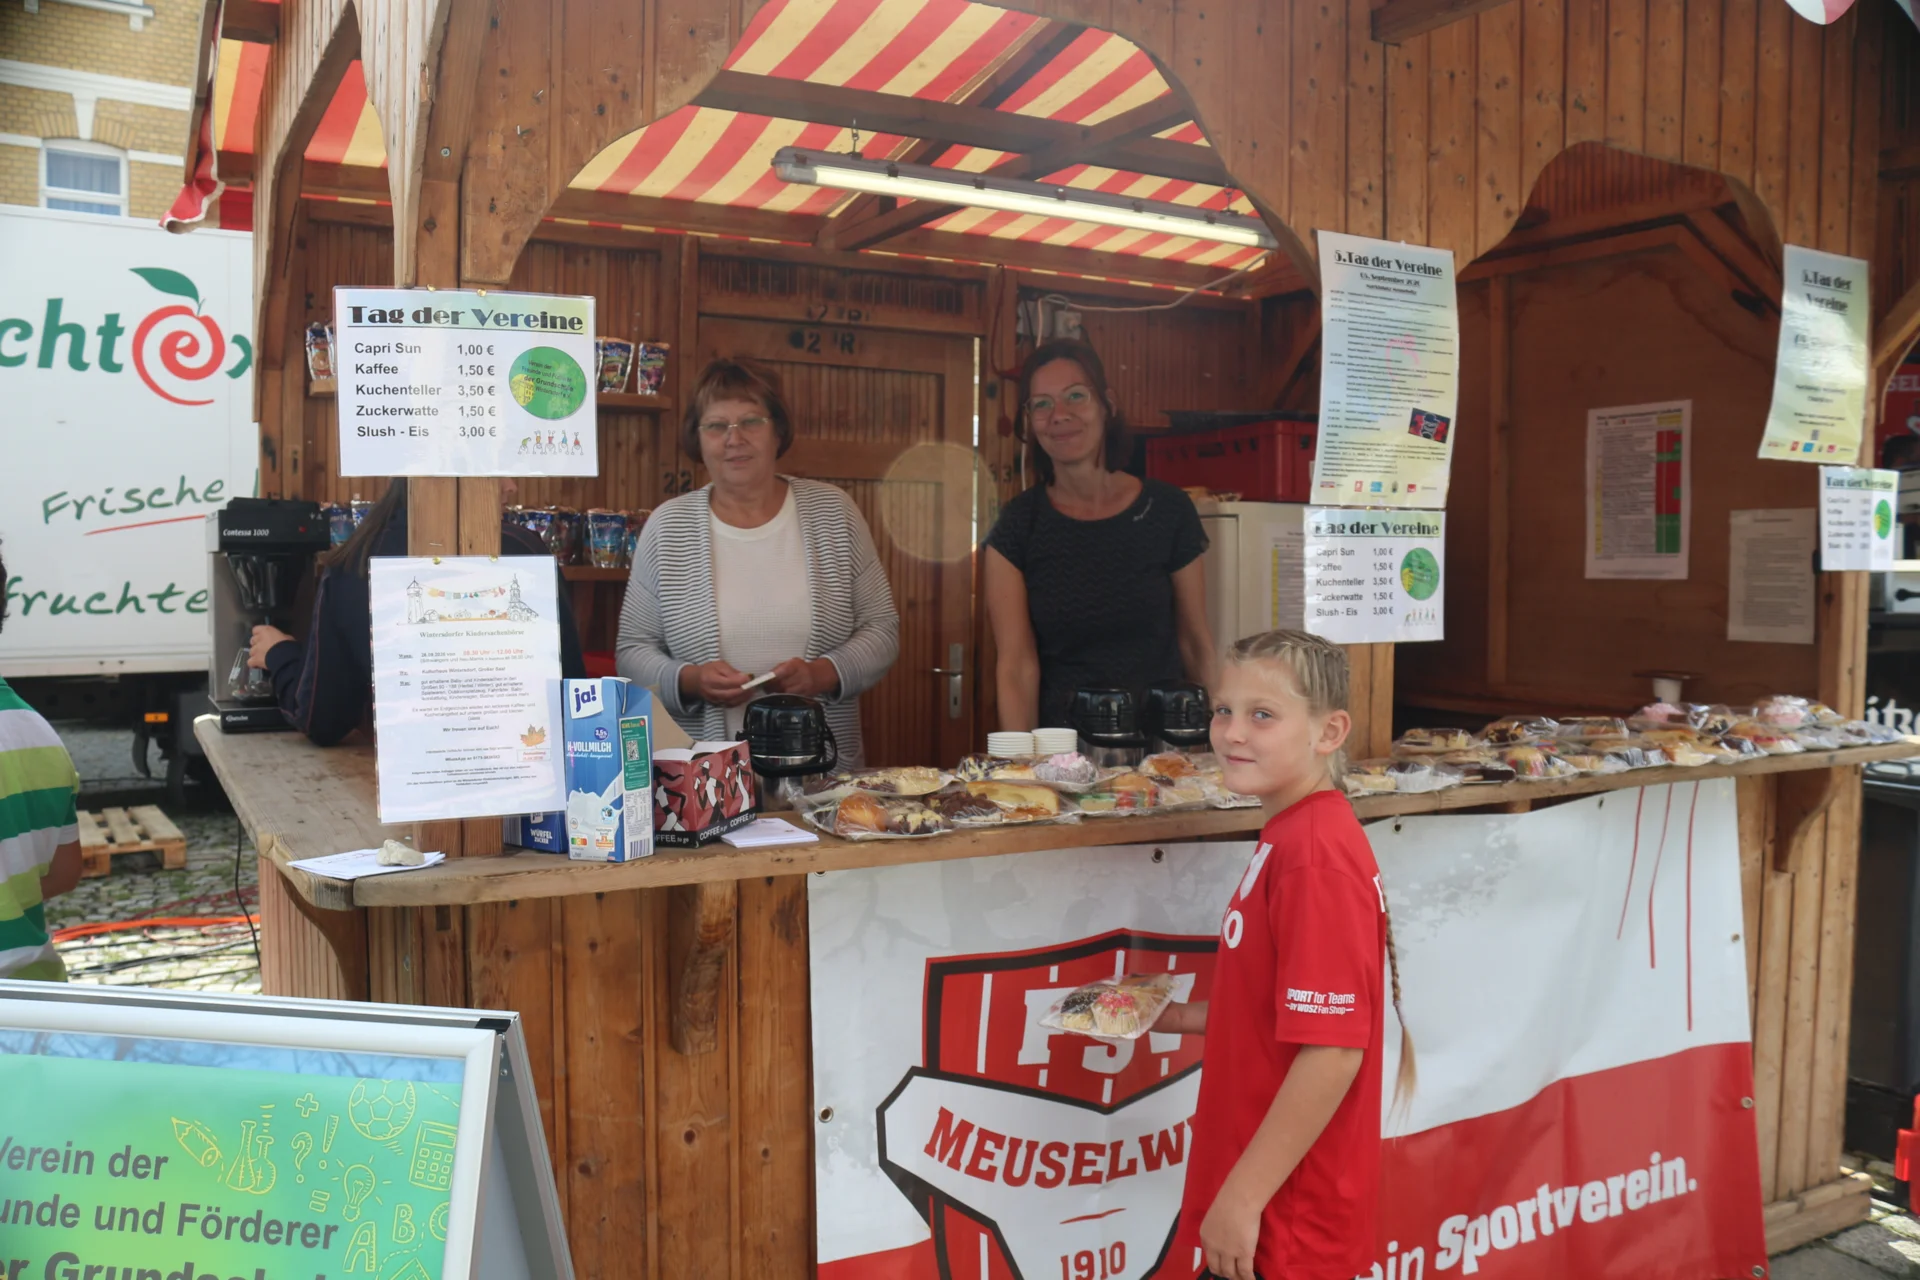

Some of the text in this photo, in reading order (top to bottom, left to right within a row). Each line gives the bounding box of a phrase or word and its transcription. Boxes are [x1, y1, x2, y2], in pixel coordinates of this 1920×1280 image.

[1371, 256, 1392, 269] der
[1394, 259, 1443, 276] Vereine
[347, 306, 584, 331] Tag der Vereine
[354, 342, 495, 357] Capri Sun 1,00 €
[355, 363, 495, 377] Kaffee 1,50 €
[355, 384, 496, 397] Kuchenteller 3,50 €
[355, 405, 496, 418] Zuckerwatte 1,50 €
[357, 425, 396, 437] Slush
[408, 426, 430, 437] Eis
[459, 426, 485, 438] 3,00
[488, 426, 497, 437] €
[42, 474, 225, 525] Frische
[222, 528, 270, 537] Contessa 1000
[1350, 521, 1378, 534] der
[1381, 521, 1440, 535] Vereine
[1340, 548, 1355, 556] Sun
[1372, 548, 1388, 557] 1,00
[1388, 548, 1393, 556] €
[1372, 563, 1388, 572] 1,50
[1388, 563, 1393, 571] €
[1316, 577, 1393, 586] Kuchenteller 3,50 €
[1372, 592, 1388, 601] 1,50
[1388, 592, 1393, 600] €
[1316, 608, 1339, 617] Slush
[1346, 608, 1358, 616] Eis
[1372, 607, 1388, 615] 3,00
[1389, 607, 1394, 615] €
[465, 629, 525, 637] Kindersachenbörse
[574, 684, 597, 713] ja!
[567, 741, 612, 753] H-VOLLMILCH
[730, 813, 749, 827] COFFEE
[530, 828, 553, 839] WÜRFEL
[700, 826, 720, 840] COFFEE
[1313, 992, 1327, 1004] for
[1328, 992, 1355, 1005] Teams
[1318, 1005, 1329, 1014] Fan
[1329, 1006, 1346, 1015] Shop
[108, 1145, 169, 1180] der
[1435, 1151, 1697, 1276] Sportverein.
[94, 1201, 165, 1235] und
[176, 1202, 339, 1250] Förderer
[1060, 1241, 1127, 1280] 1910
